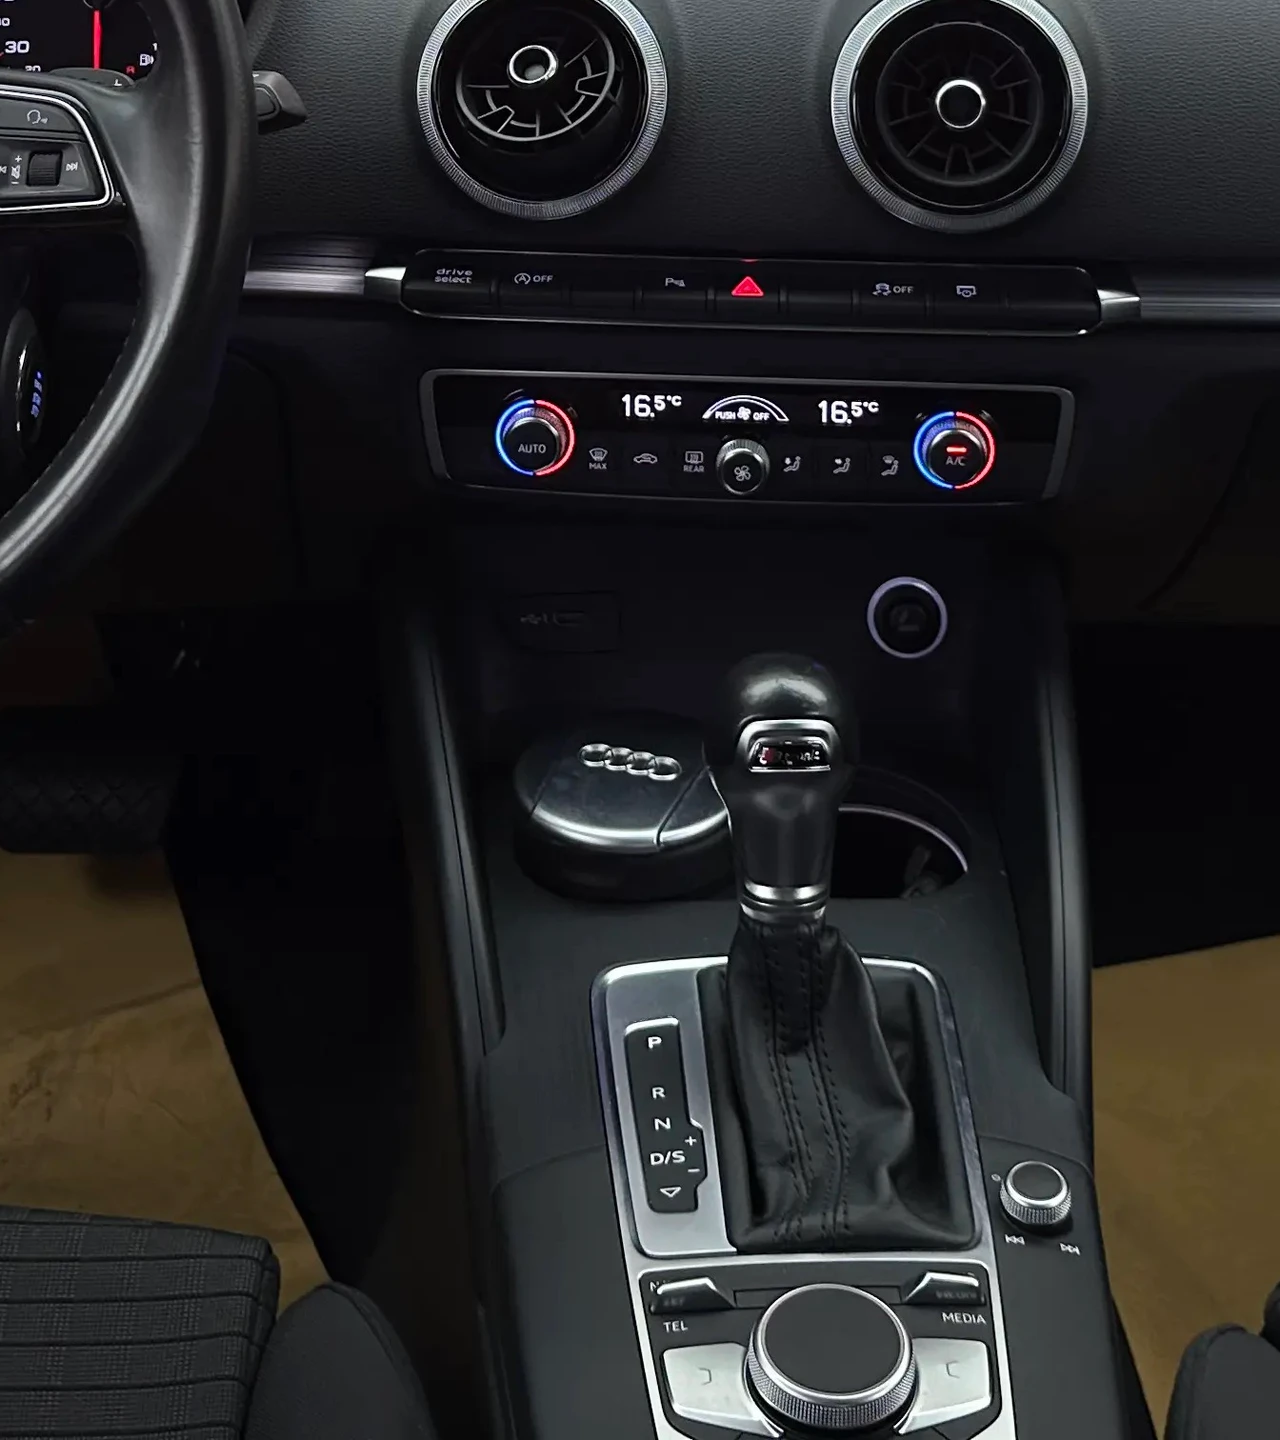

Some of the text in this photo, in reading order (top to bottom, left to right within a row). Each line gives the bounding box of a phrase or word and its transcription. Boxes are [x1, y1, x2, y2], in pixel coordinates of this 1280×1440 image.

[4, 40, 30, 53] 30
[436, 268, 473, 277] drive
[434, 274, 472, 284] select
[532, 275, 553, 283] OFF
[892, 285, 914, 294] OFF
[714, 411, 770, 421] PUSH OFF
[517, 443, 547, 454] AUTO
[588, 462, 608, 470] MAX
[945, 457, 966, 466] A/C
[683, 464, 705, 473] REAR
[647, 1036, 662, 1049] P
[652, 1086, 666, 1099] R
[654, 1117, 672, 1131] N
[650, 1150, 686, 1165] D/S
[941, 1312, 987, 1326] MEDIA
[663, 1320, 689, 1333] TEL
